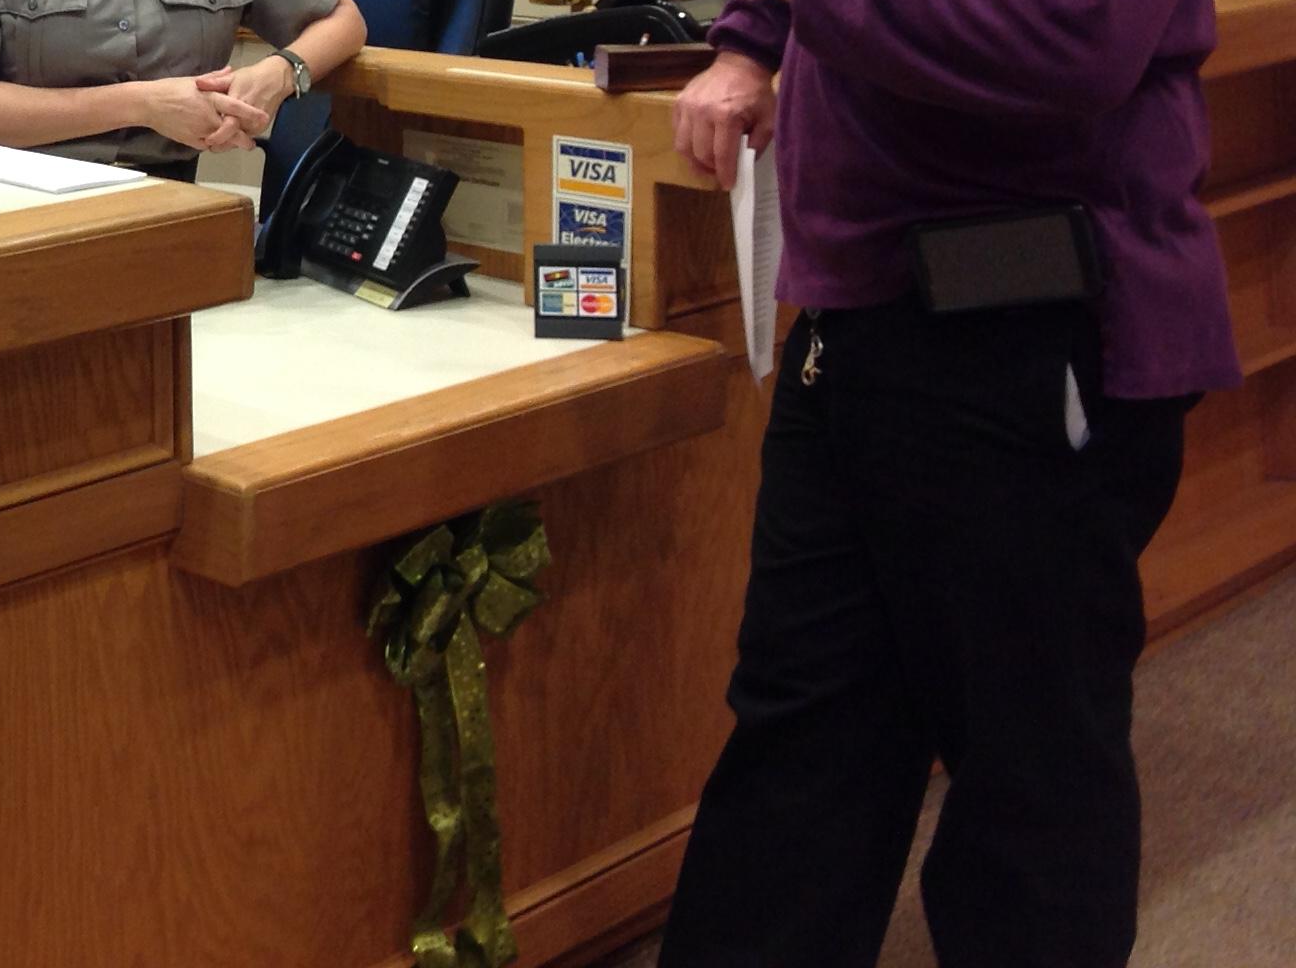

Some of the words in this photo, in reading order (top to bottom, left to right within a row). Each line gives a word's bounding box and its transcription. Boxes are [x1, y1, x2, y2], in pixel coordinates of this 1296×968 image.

[569, 158, 617, 184] VISA
[573, 208, 607, 227] VISA
[585, 274, 609, 284] VISA
